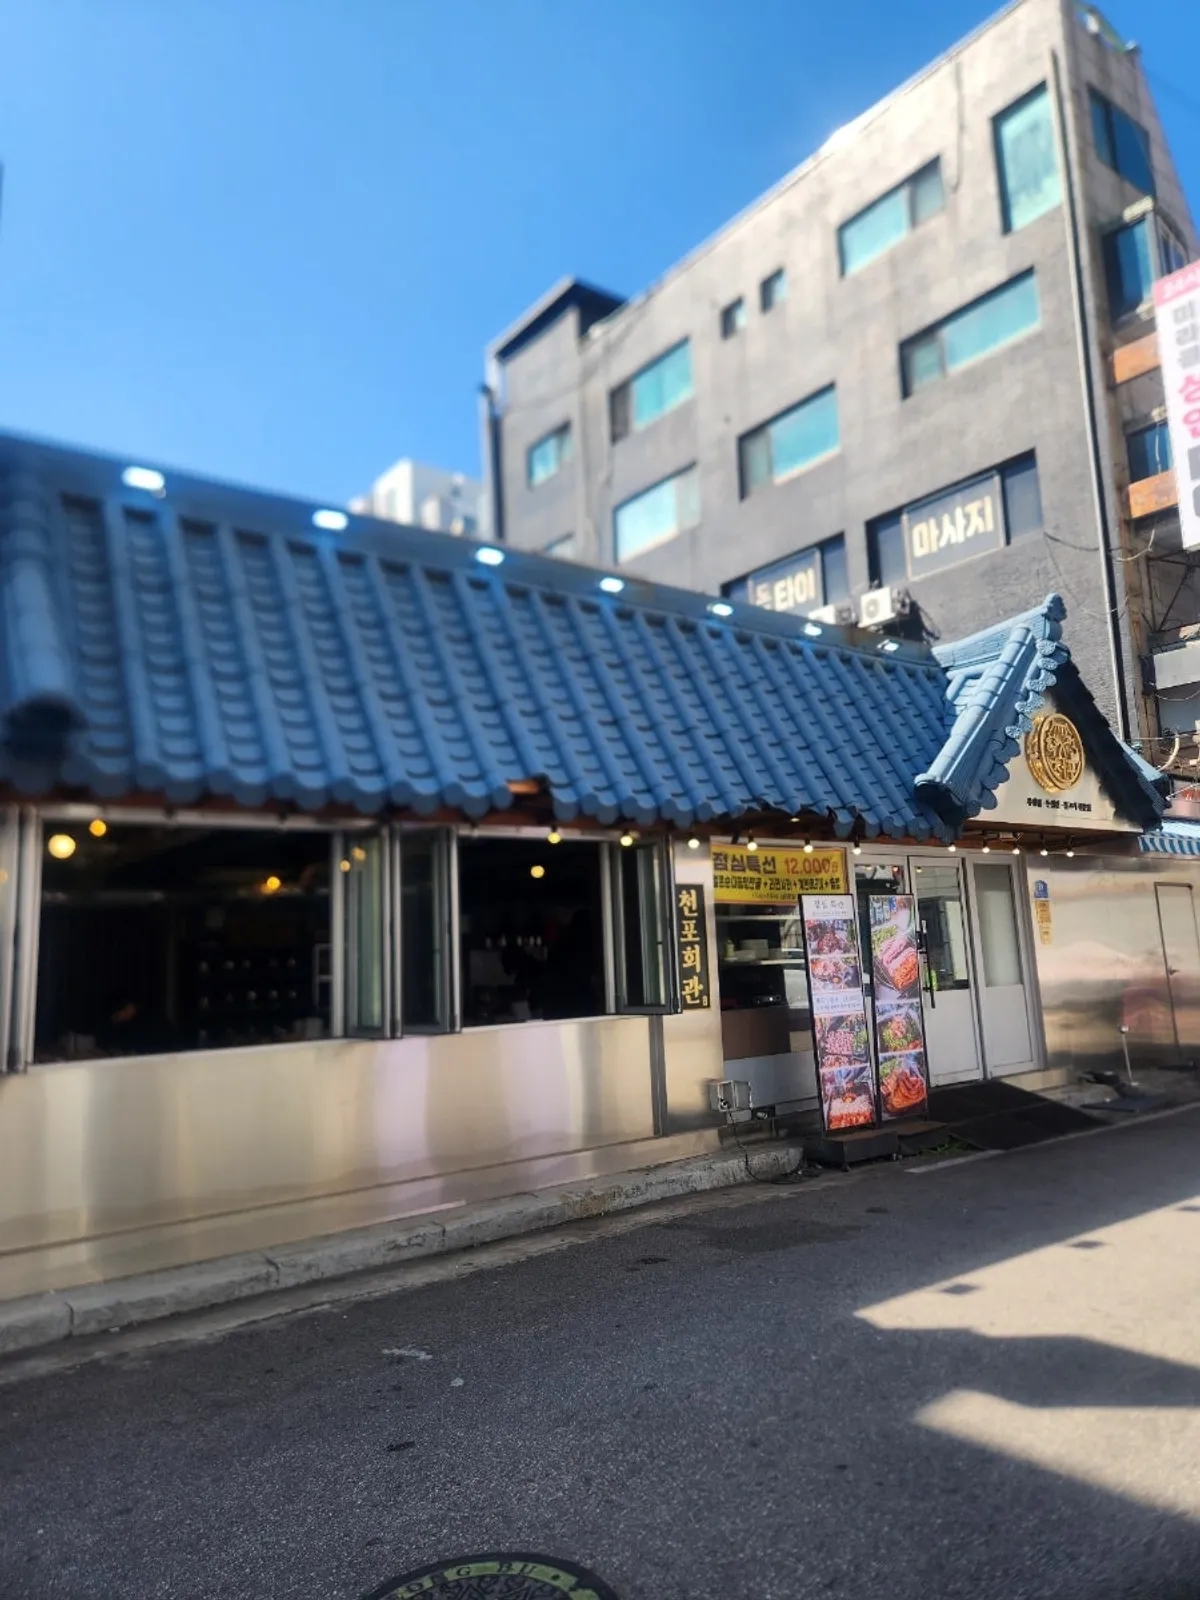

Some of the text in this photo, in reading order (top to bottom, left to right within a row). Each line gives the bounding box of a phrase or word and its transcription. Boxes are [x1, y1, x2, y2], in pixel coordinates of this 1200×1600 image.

[913, 495, 995, 557] 마사지
[713, 851, 777, 875] 점심특선
[678, 888, 704, 1004] 천포회관
